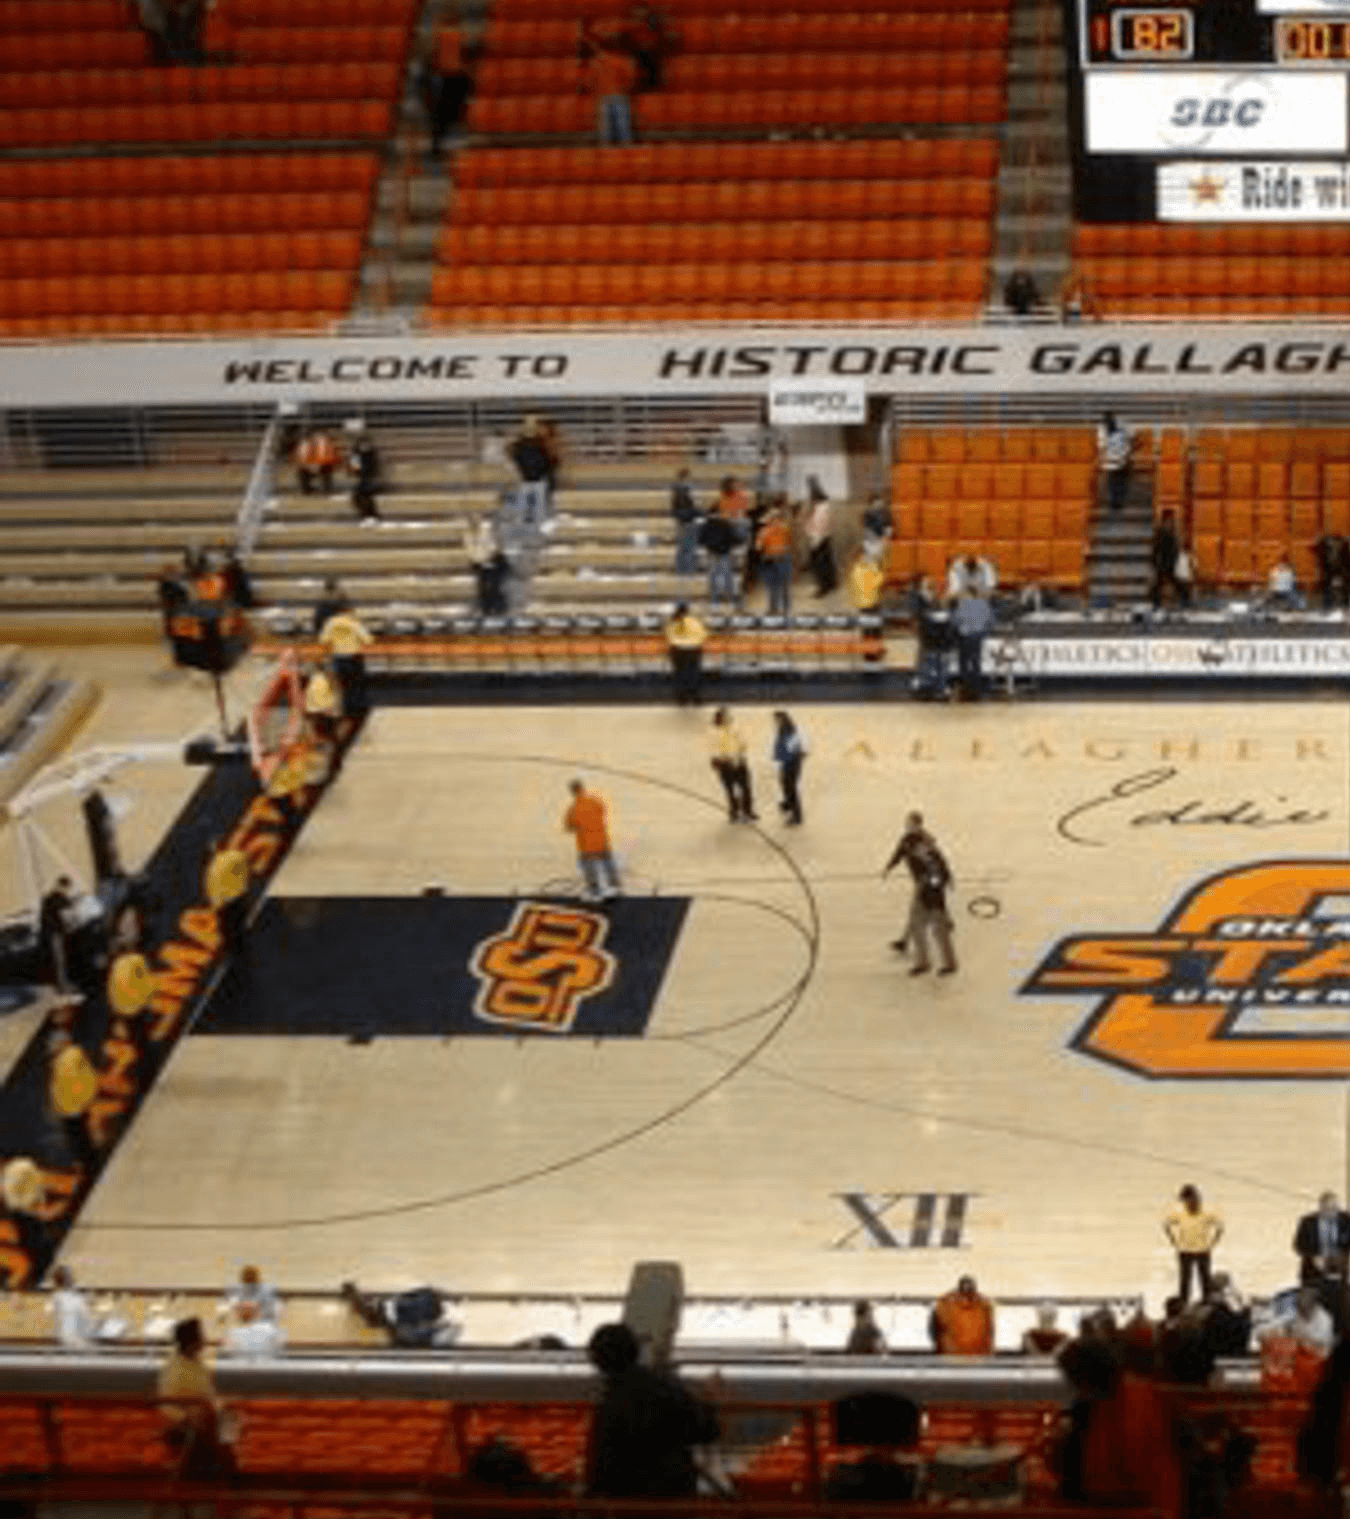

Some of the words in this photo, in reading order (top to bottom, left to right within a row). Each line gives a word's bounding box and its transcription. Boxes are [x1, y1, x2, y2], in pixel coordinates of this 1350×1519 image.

[1134, 15, 1180, 50] 82
[1171, 99, 1263, 127] SBC
[1242, 167, 1301, 207] Ride
[225, 356, 477, 384] WELCOME
[500, 355, 568, 377] TO
[660, 346, 1000, 378] HISTORIC
[1059, 769, 1330, 846] Eddie
[828, 1192, 987, 1250] XII
